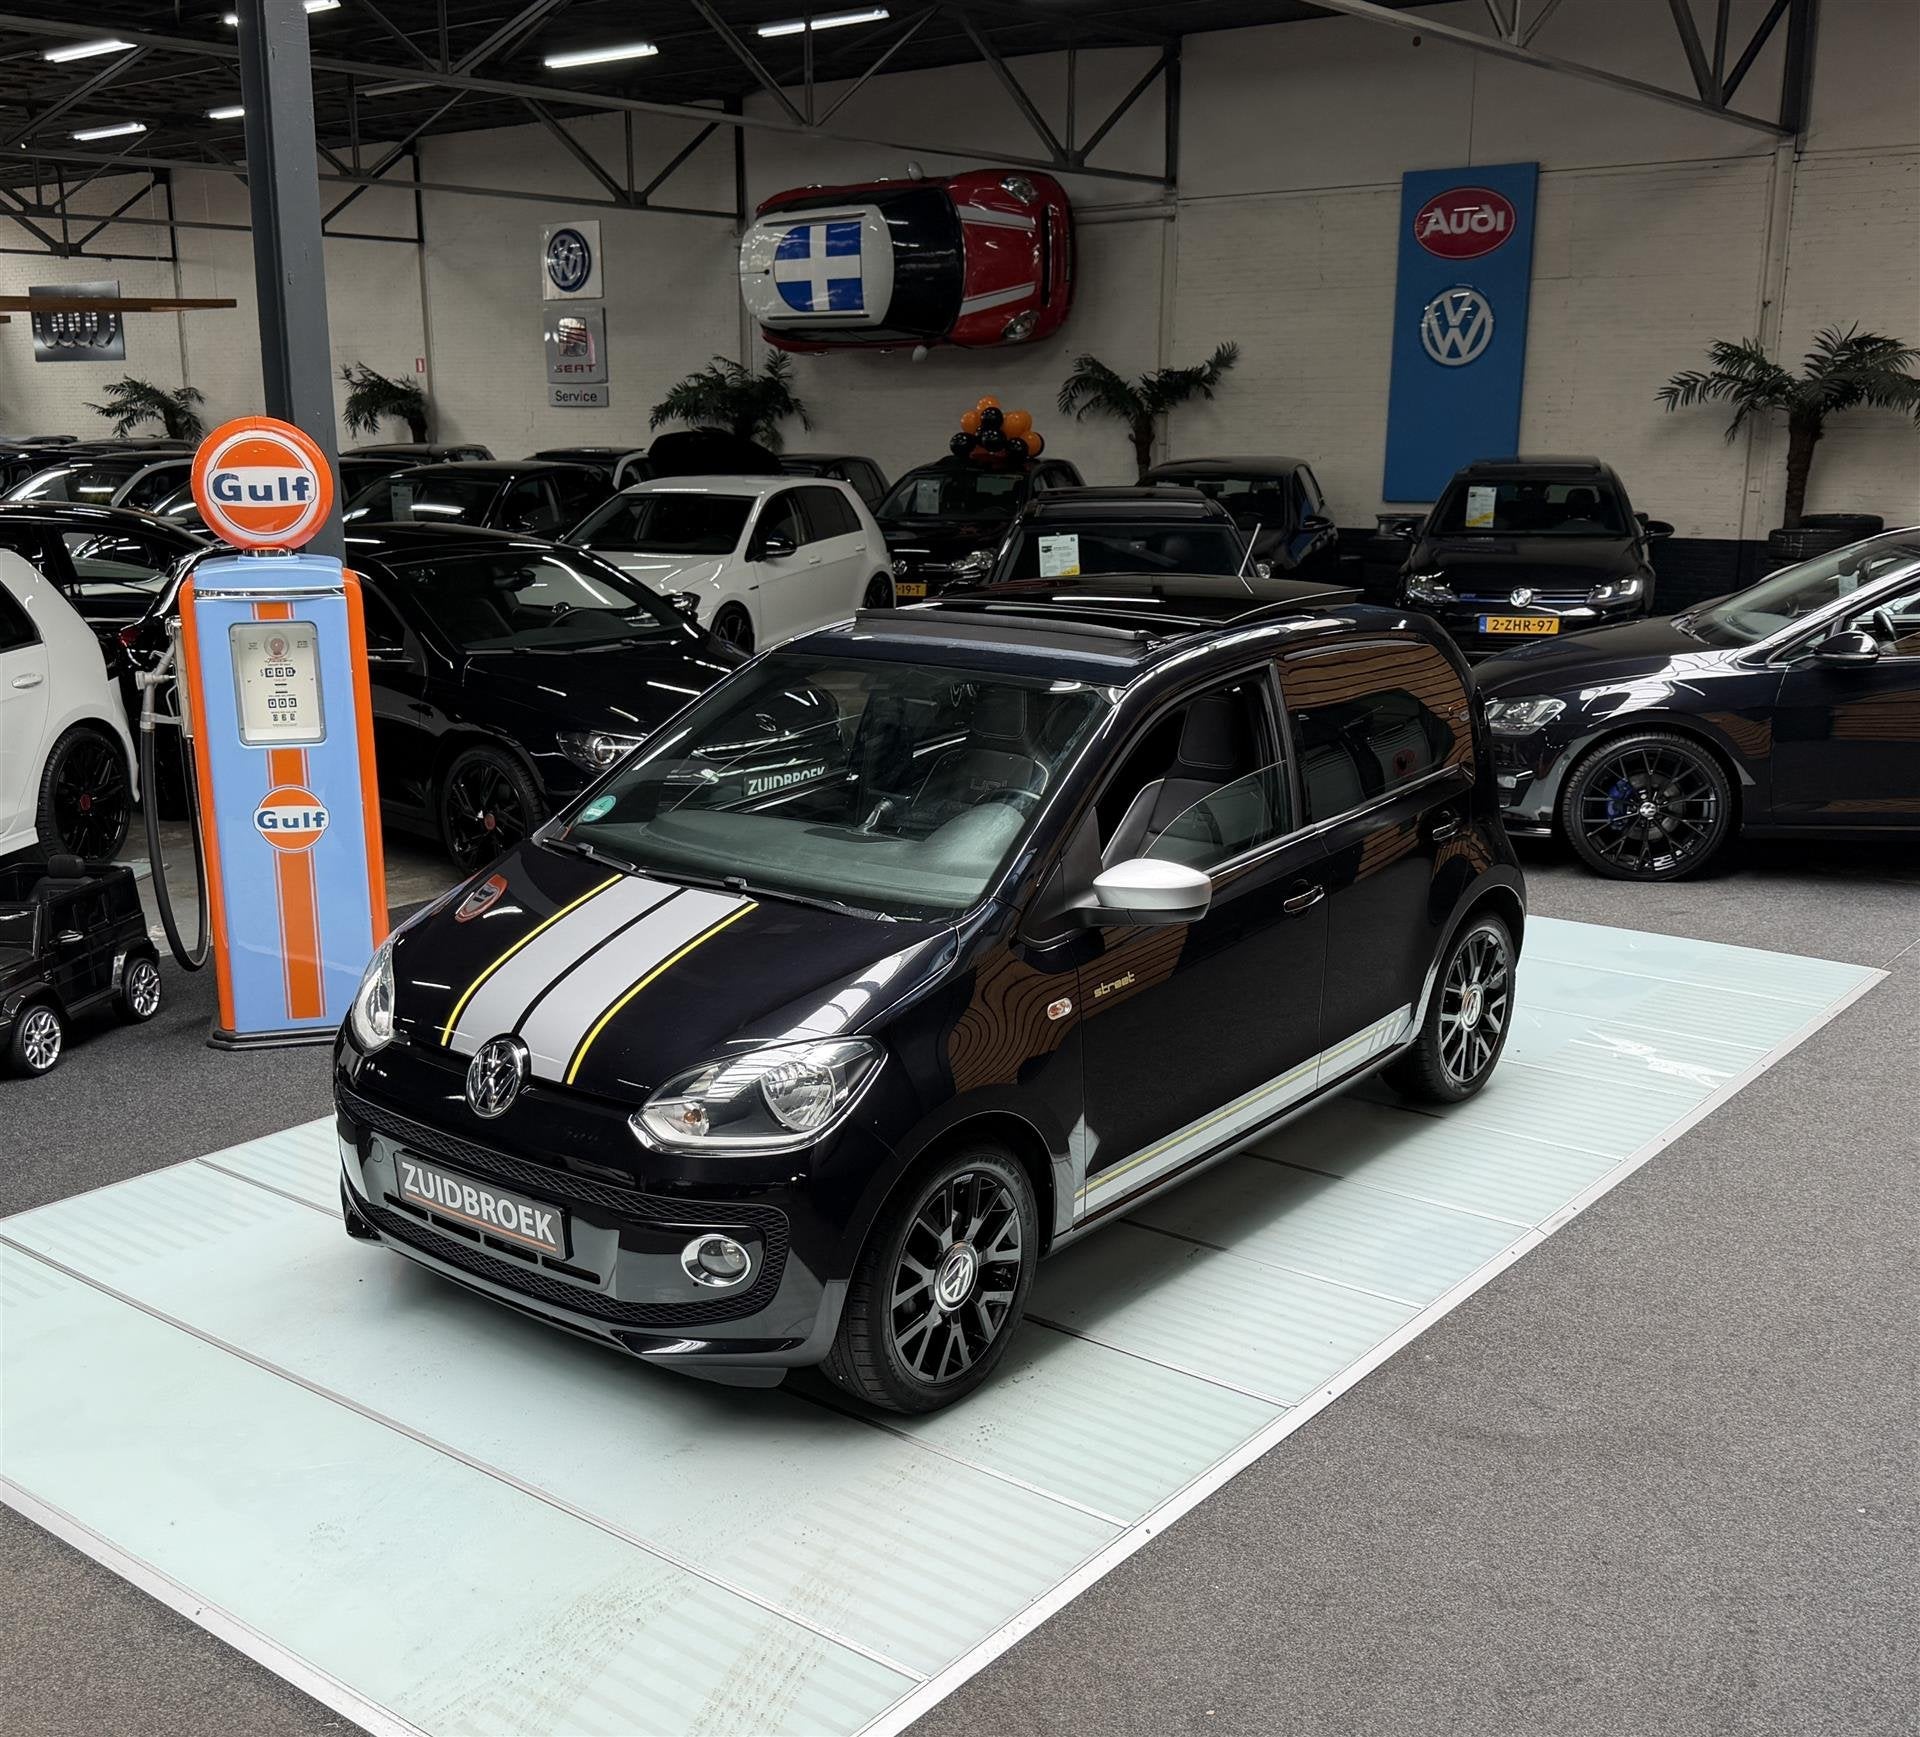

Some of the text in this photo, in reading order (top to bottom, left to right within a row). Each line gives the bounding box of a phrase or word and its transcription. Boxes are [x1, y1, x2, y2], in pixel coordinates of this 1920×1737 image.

[554, 364, 596, 374] SEAT
[556, 390, 598, 402] Service
[212, 473, 310, 502] Gulf
[1492, 619, 1554, 632] 2-ZHR-97
[257, 810, 326, 829] Gulf
[1094, 971, 1136, 998] street
[401, 1161, 556, 1245] ZUIDBROEK
